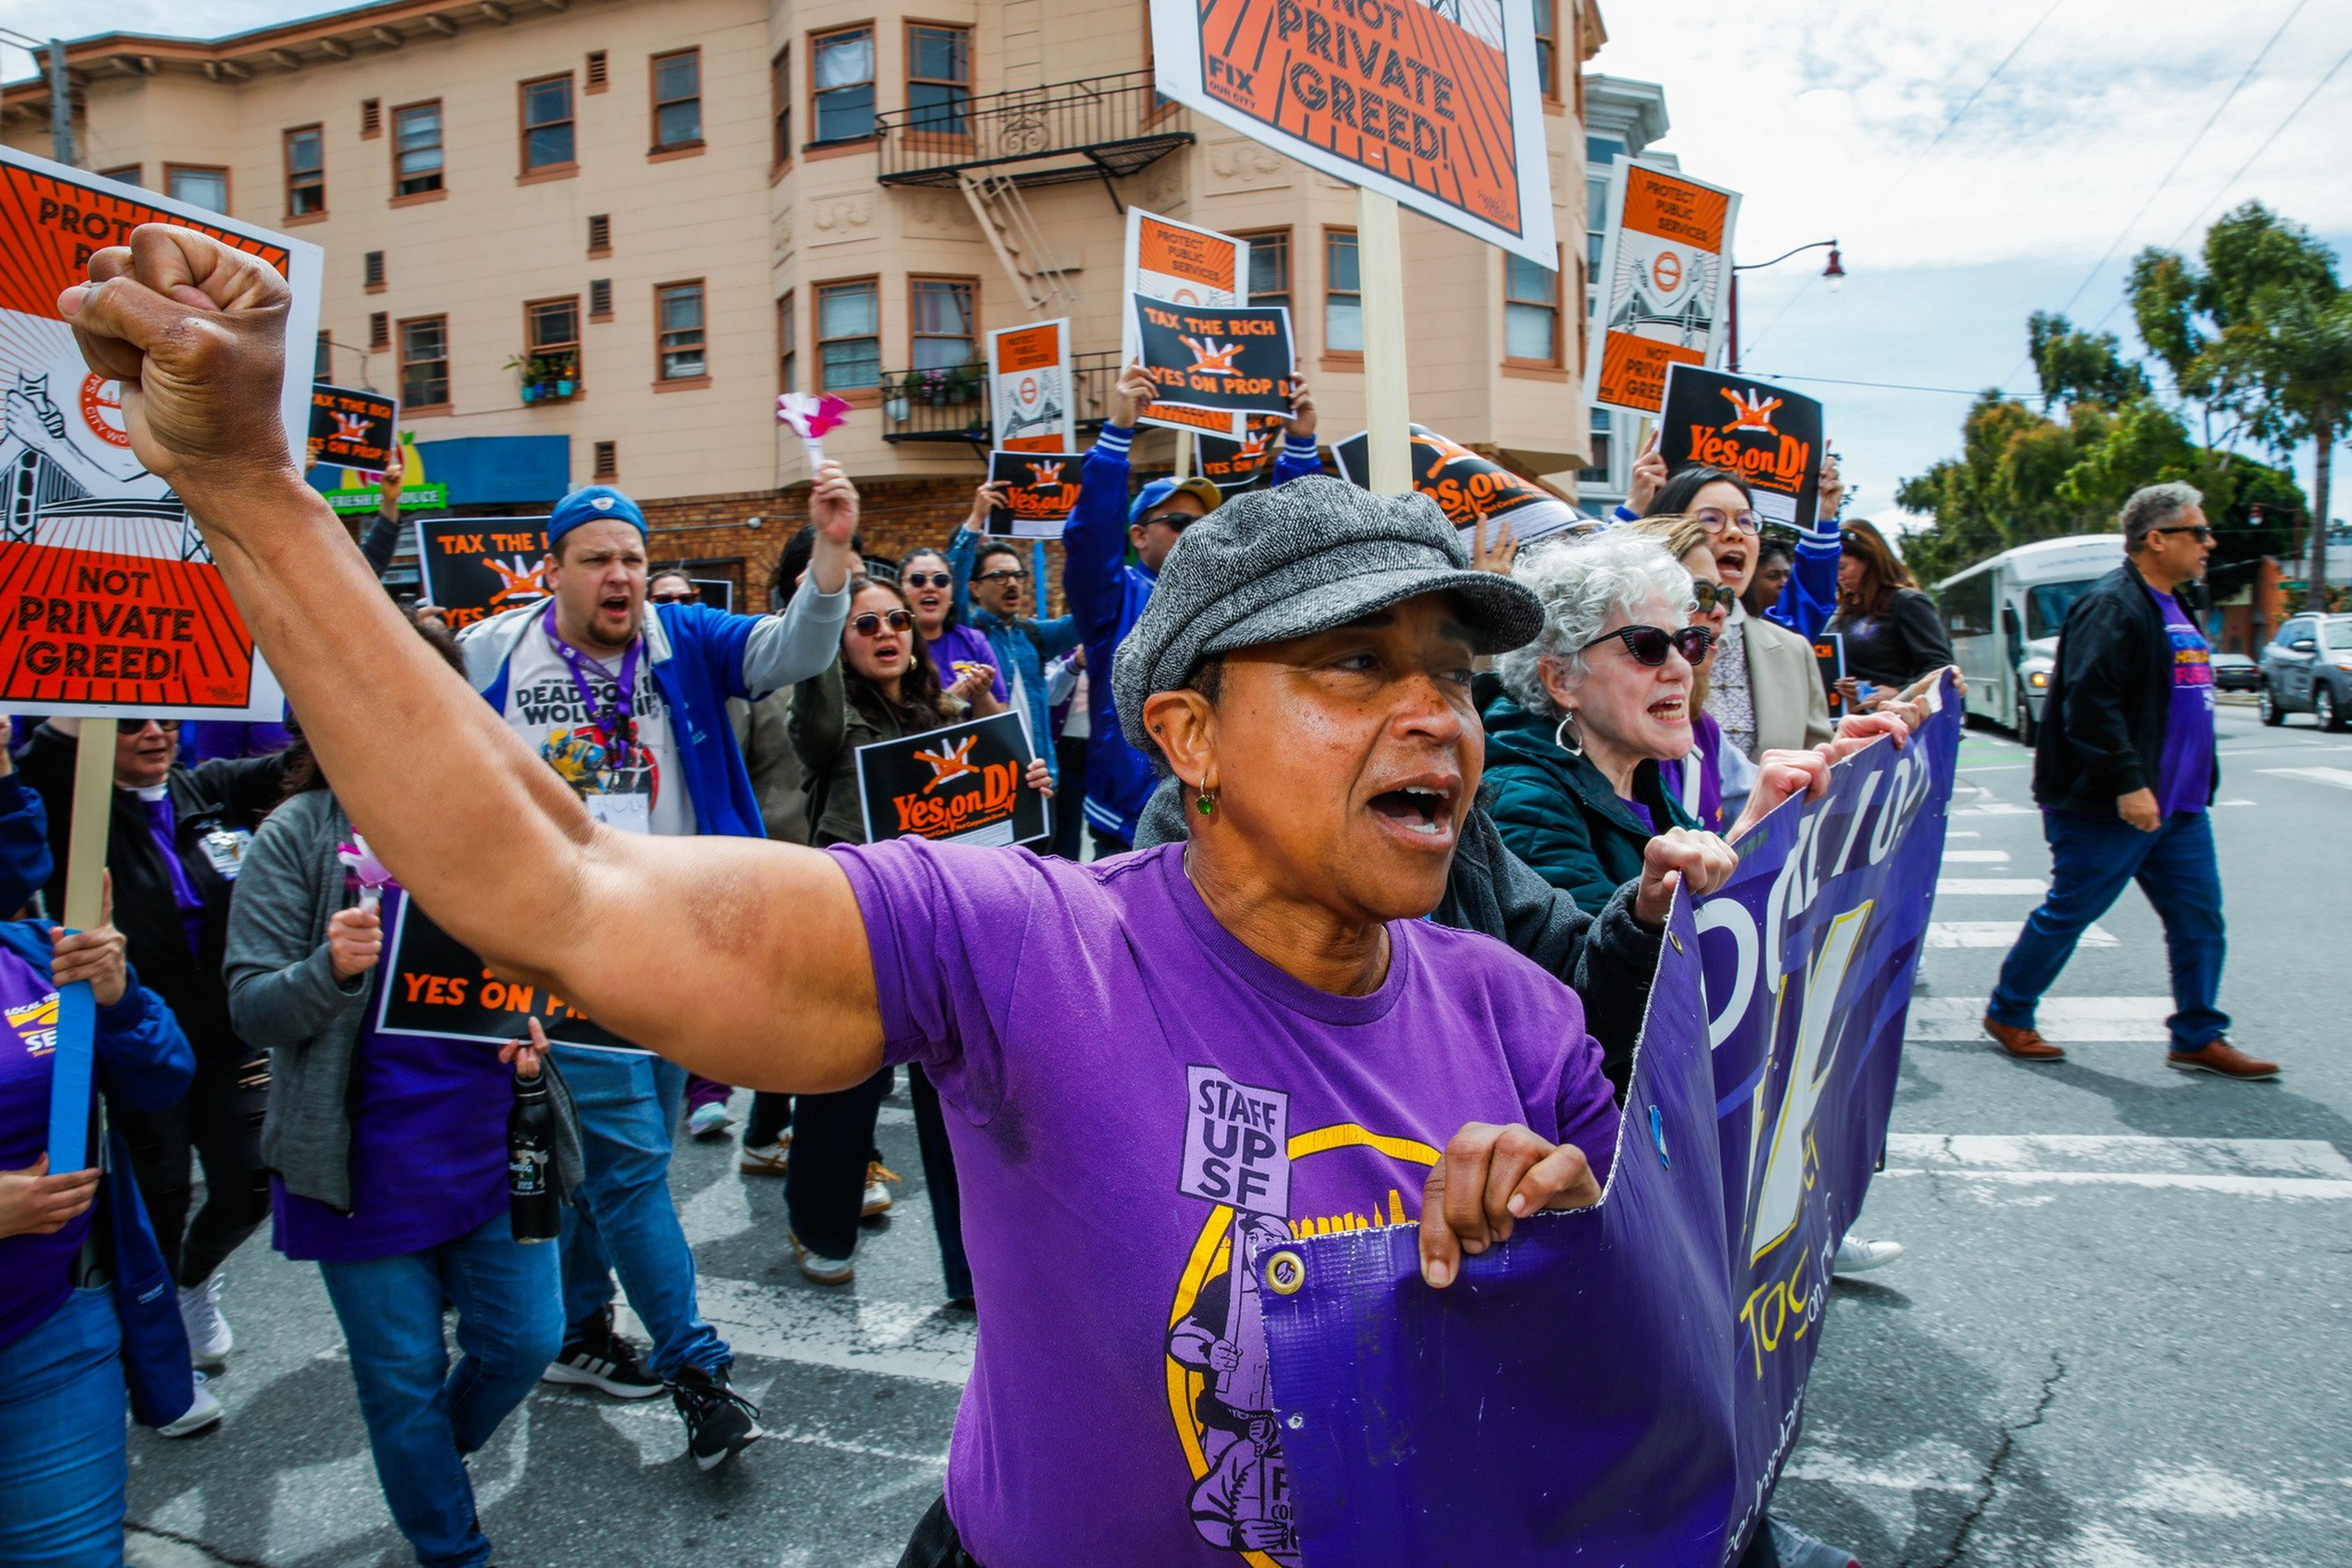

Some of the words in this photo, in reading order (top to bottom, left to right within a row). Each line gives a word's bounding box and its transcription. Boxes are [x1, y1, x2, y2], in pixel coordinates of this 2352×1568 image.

[1208, 53, 1254, 96] FIX
[1277, 0, 1456, 122] PRIVATE
[1290, 61, 1449, 171] GREED!
[1646, 180, 1697, 203] PROTECT
[38, 197, 134, 248] PROT
[1655, 198, 1695, 221] PUBLIC
[1157, 229, 1207, 249] PROTECT
[1658, 217, 1708, 242] SERVICES
[1167, 244, 1205, 264] PUBLIC
[1171, 260, 1220, 282] SERVICES
[1144, 307, 1182, 330] TAX
[1184, 317, 1225, 336] THE
[1189, 375, 1219, 393] ON
[1222, 377, 1274, 394] PROP
[1687, 423, 1740, 466] Yes
[1745, 447, 1776, 473] on
[1775, 434, 1810, 478] D!
[1203, 461, 1230, 475] YES
[1006, 486, 1040, 510] Yes
[1041, 496, 1060, 510] on
[1469, 471, 1517, 499] on
[437, 533, 486, 554] TAX
[490, 532, 535, 552] THE
[77, 565, 151, 598] NOT
[16, 595, 195, 643] PRIVATE
[24, 640, 182, 682] GREED!
[892, 793, 945, 831] Yes
[950, 790, 984, 817] on
[983, 760, 1018, 810] D!
[4, 1000, 43, 1017] LOCAL
[403, 972, 469, 1006] YES
[479, 981, 534, 1014] ON
[1198, 1079, 1277, 1134] STAFF
[1203, 1116, 1277, 1167] UP
[1198, 1157, 1270, 1205] SF
